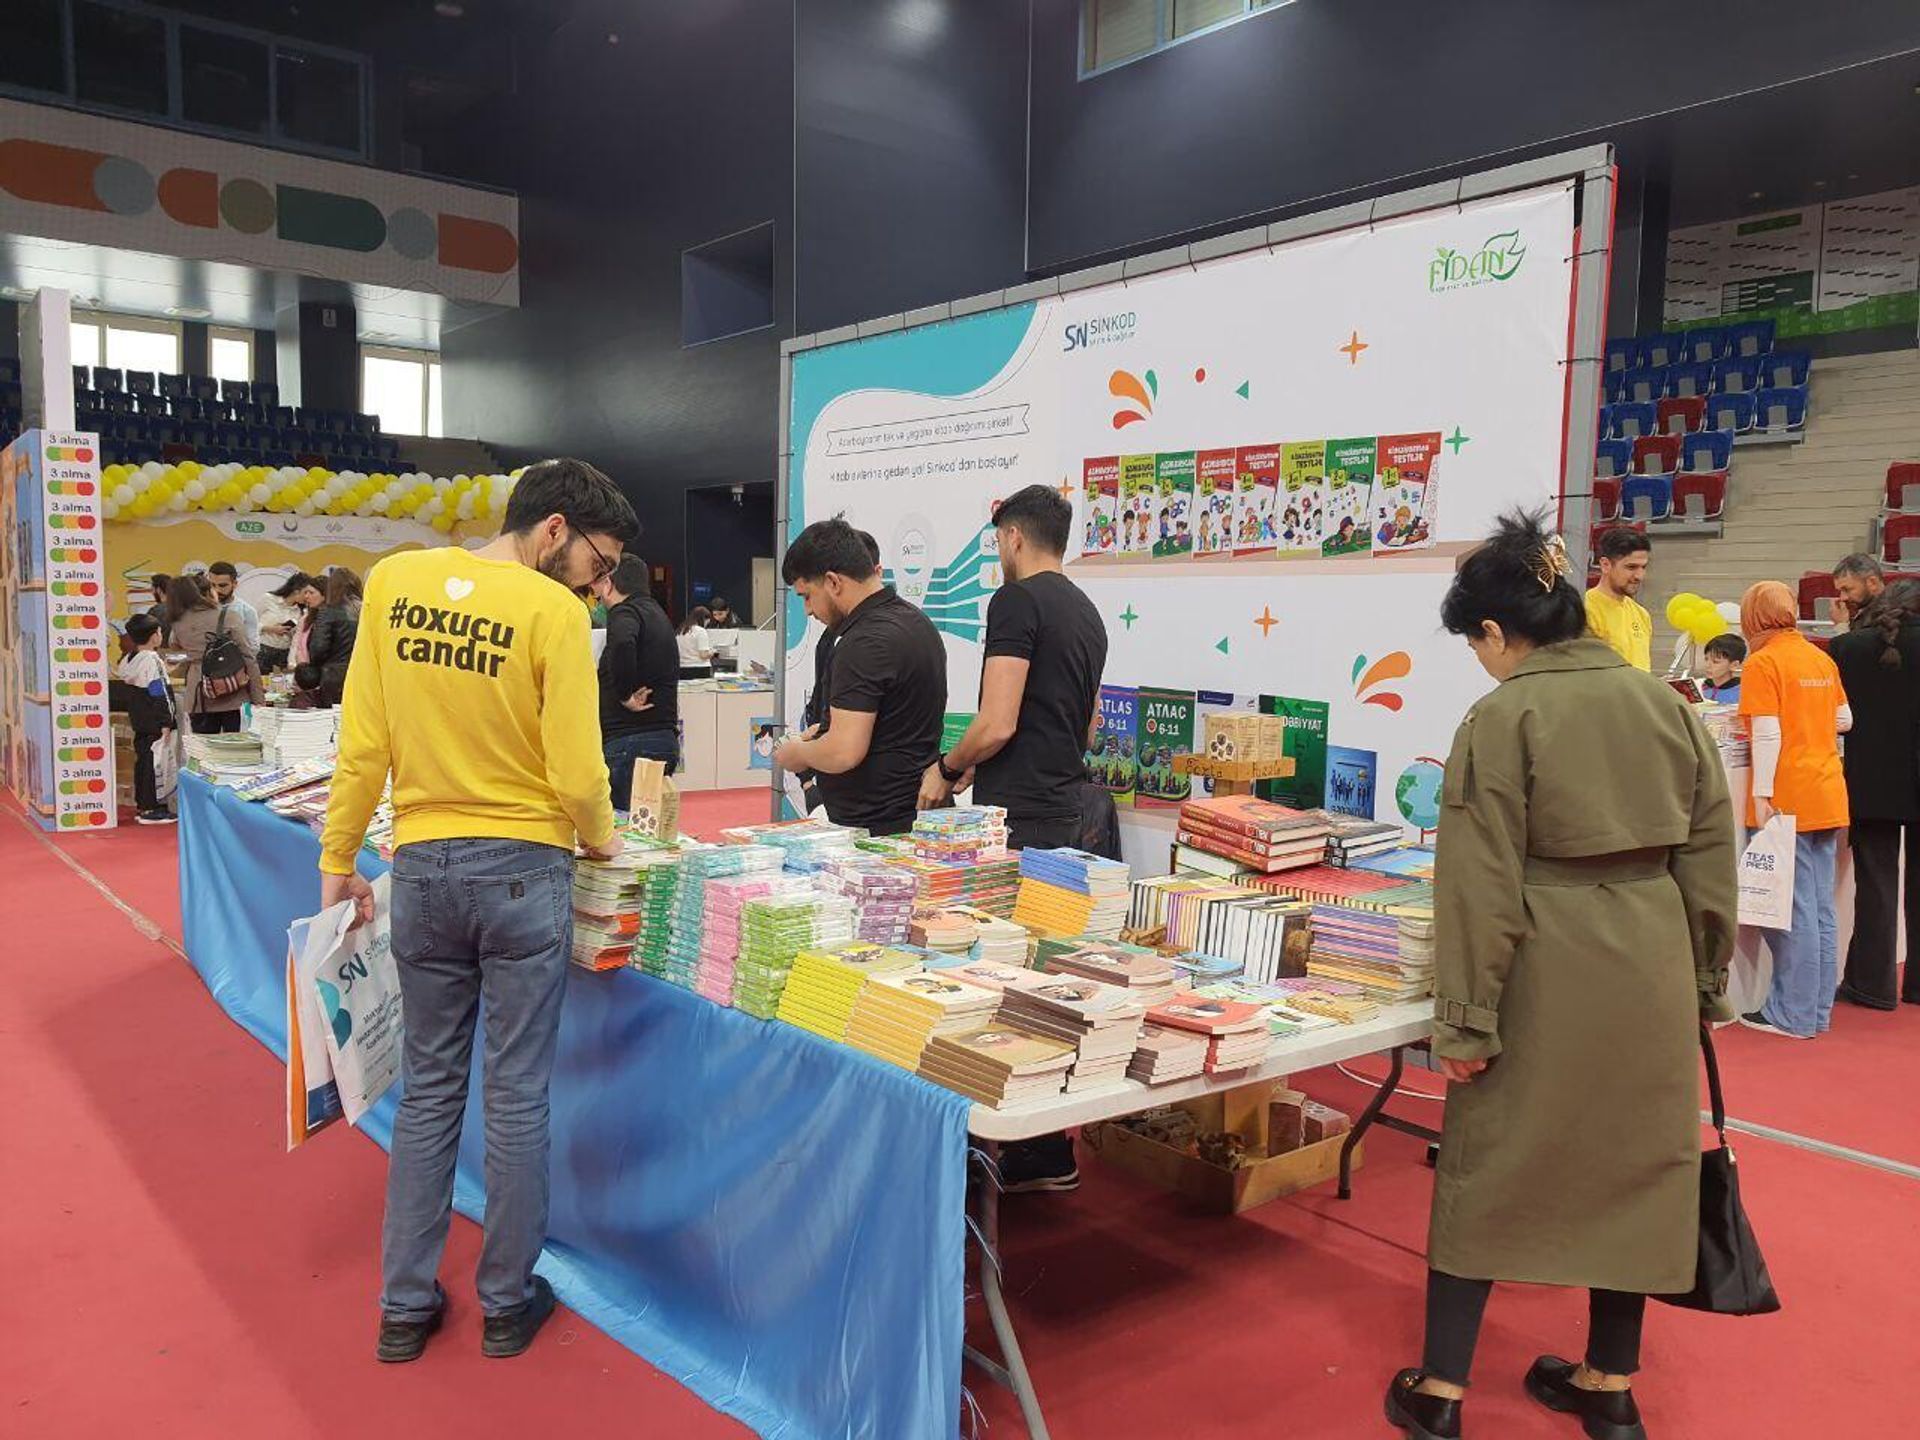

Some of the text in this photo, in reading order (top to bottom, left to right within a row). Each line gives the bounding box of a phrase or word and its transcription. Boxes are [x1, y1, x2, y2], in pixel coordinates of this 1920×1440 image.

[1064, 321, 1088, 352] SN
[49, 434, 90, 446] 3 alma
[50, 468, 91, 479] 3 alma
[51, 502, 92, 513] 3 alma
[53, 535, 93, 546] 3 alma
[54, 570, 95, 580] 3 alma
[55, 603, 96, 612] 3 alma
[389, 597, 514, 649] #oxucu
[57, 636, 97, 646] 3 alma
[396, 636, 507, 678] candır
[58, 669, 99, 679] 3 alma
[59, 703, 100, 712] 3 alma
[1282, 716, 1323, 731] DƏBİYYAT
[1159, 724, 1180, 736] 6-11
[61, 735, 101, 745] 3 alma
[62, 768, 102, 778] 3 alma
[63, 800, 103, 811] 3 alma
[1746, 852, 1775, 864] TEAS
[1745, 861, 1775, 871] PRESS
[338, 952, 369, 994] SN
